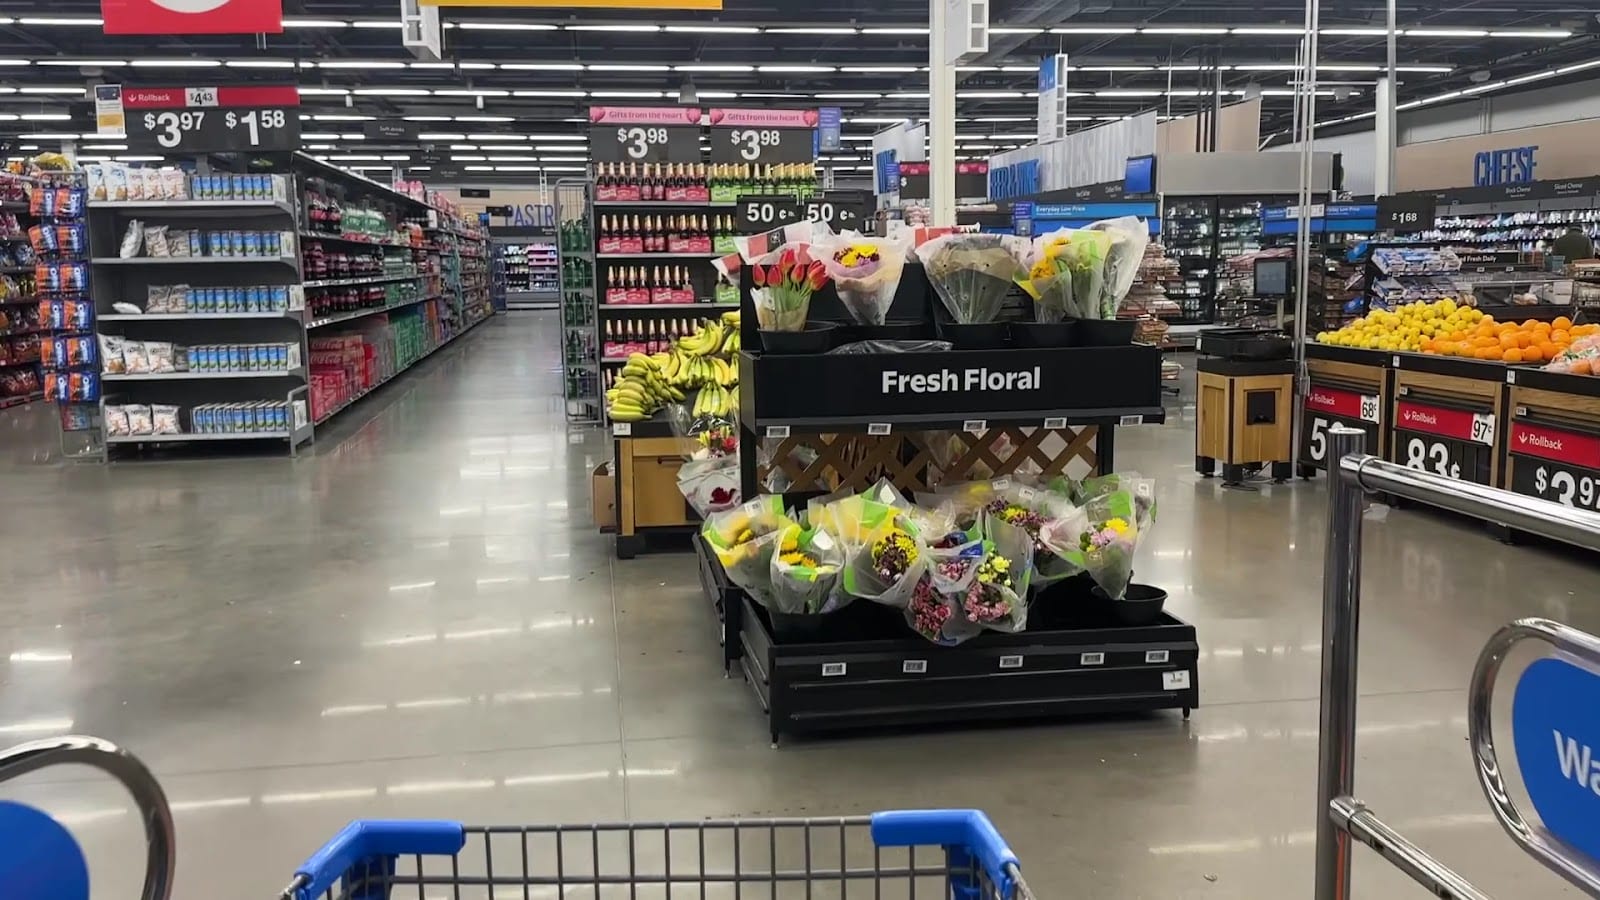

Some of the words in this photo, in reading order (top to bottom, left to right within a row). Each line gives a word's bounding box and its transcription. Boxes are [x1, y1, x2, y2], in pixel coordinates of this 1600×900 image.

[138, 94, 171, 102] Rollback
[609, 111, 627, 119] Gifts
[747, 113, 765, 121] from
[617, 127, 668, 159] $398
[731, 129, 780, 161] $398
[1474, 146, 1539, 187] CHEESE
[1467, 253, 1481, 262] Fresh
[1482, 252, 1497, 264] Daily
[881, 367, 959, 394] Fresh
[964, 366, 1041, 392] Floral
[1314, 393, 1336, 406] Rollback
[1411, 410, 1437, 425] Rollback
[1529, 433, 1563, 451] Rollback
